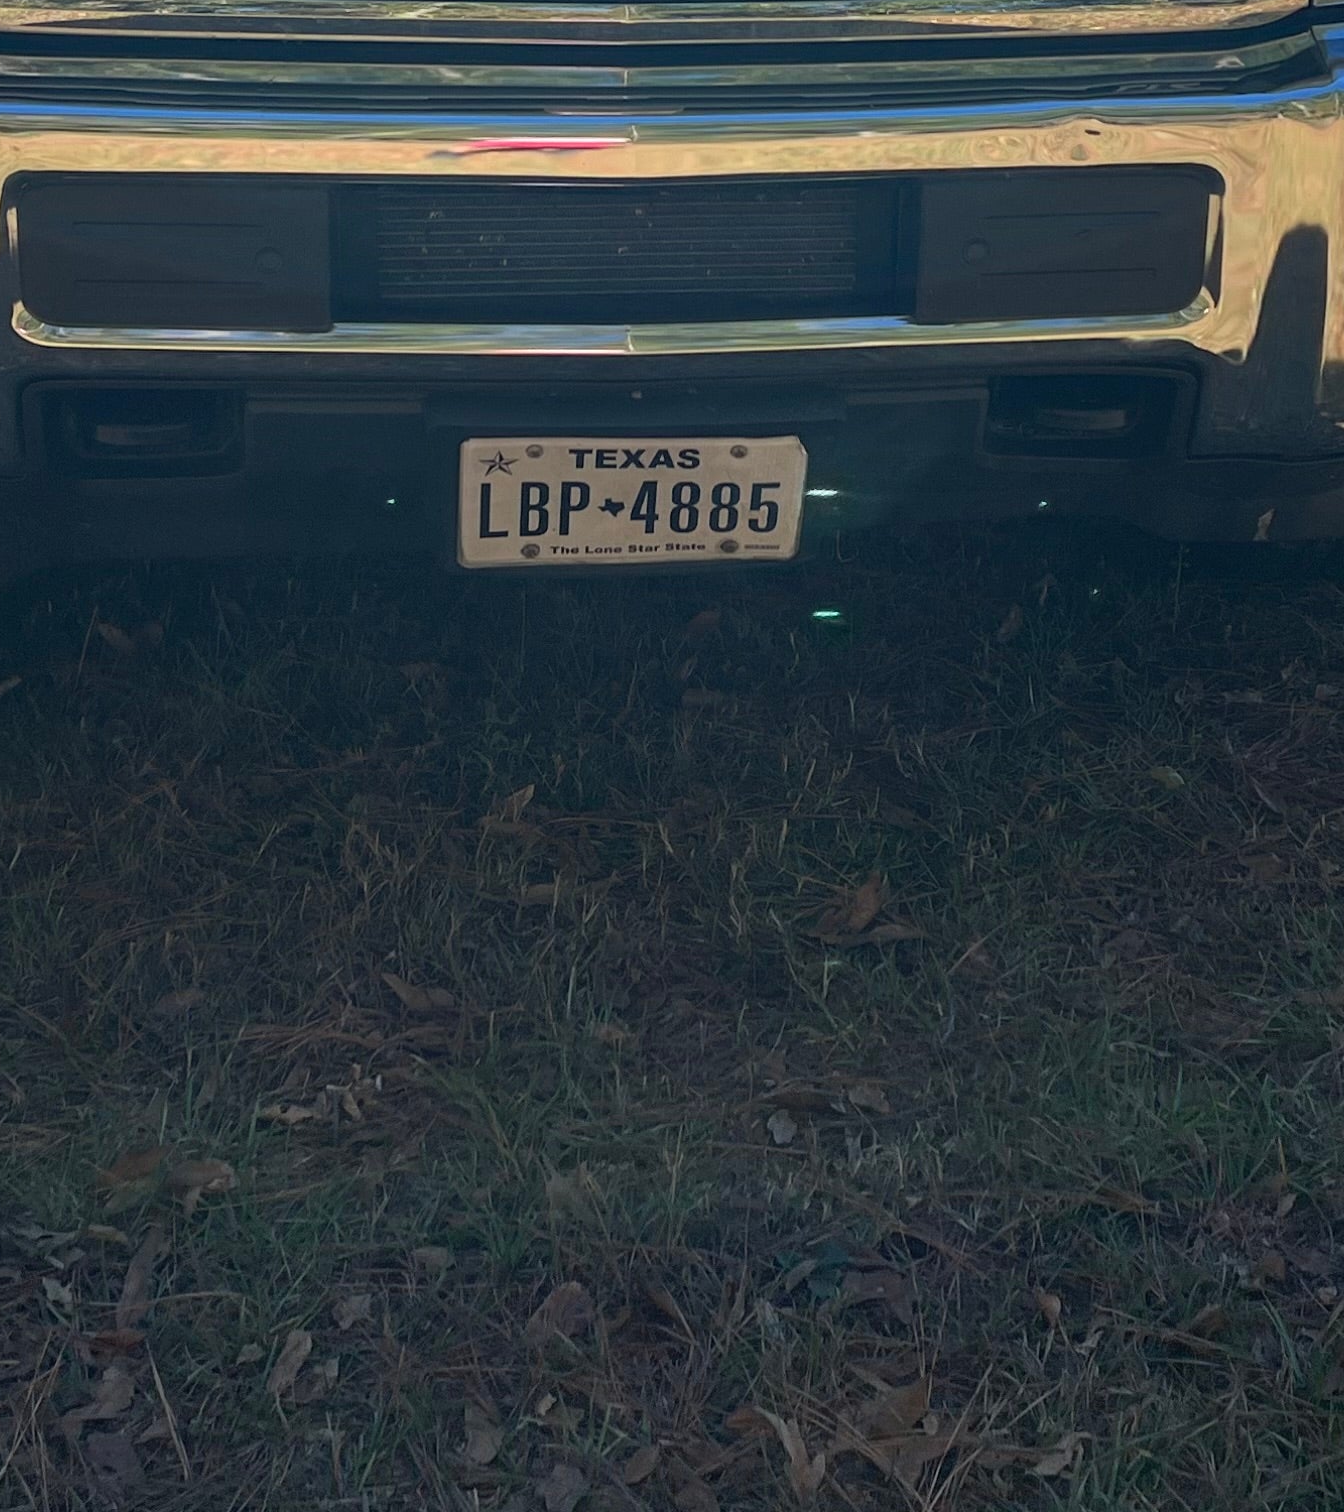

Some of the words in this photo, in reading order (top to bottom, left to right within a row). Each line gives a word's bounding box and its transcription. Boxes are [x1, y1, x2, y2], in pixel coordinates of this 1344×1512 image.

[568, 448, 701, 469] TEXAS
[479, 481, 591, 538] LBP
[630, 480, 781, 534] 4885
[550, 546, 580, 555] The
[585, 546, 623, 555] Lone
[628, 544, 661, 554] Star
[665, 543, 706, 551] State
